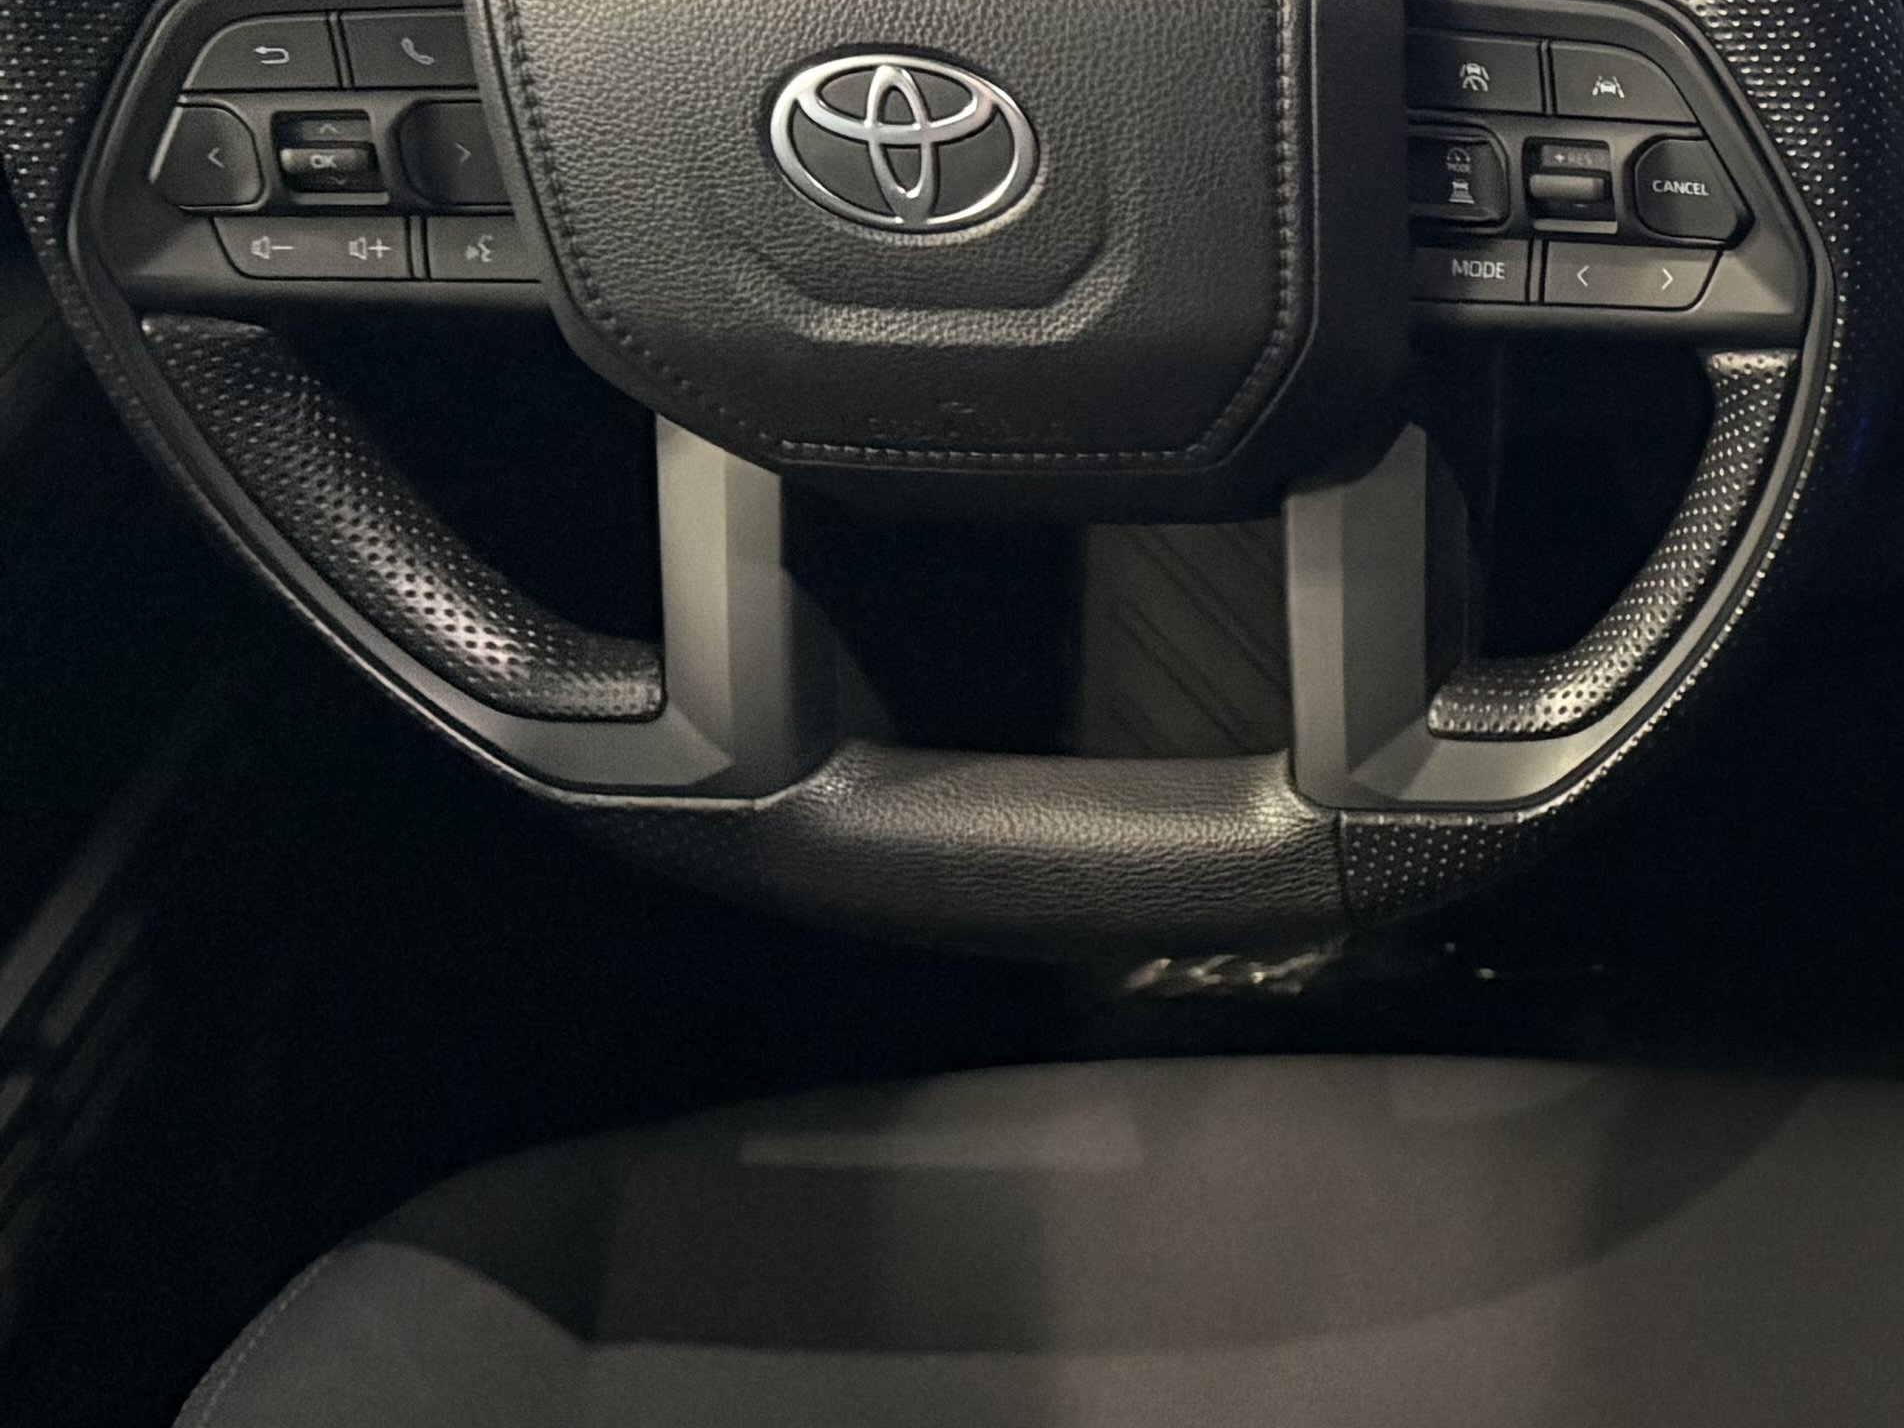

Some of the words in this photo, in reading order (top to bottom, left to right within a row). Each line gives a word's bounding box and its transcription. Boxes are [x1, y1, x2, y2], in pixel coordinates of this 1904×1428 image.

[309, 154, 337, 169] OK
[1652, 179, 1710, 196] CANCEL
[1452, 258, 1506, 280] MODE
